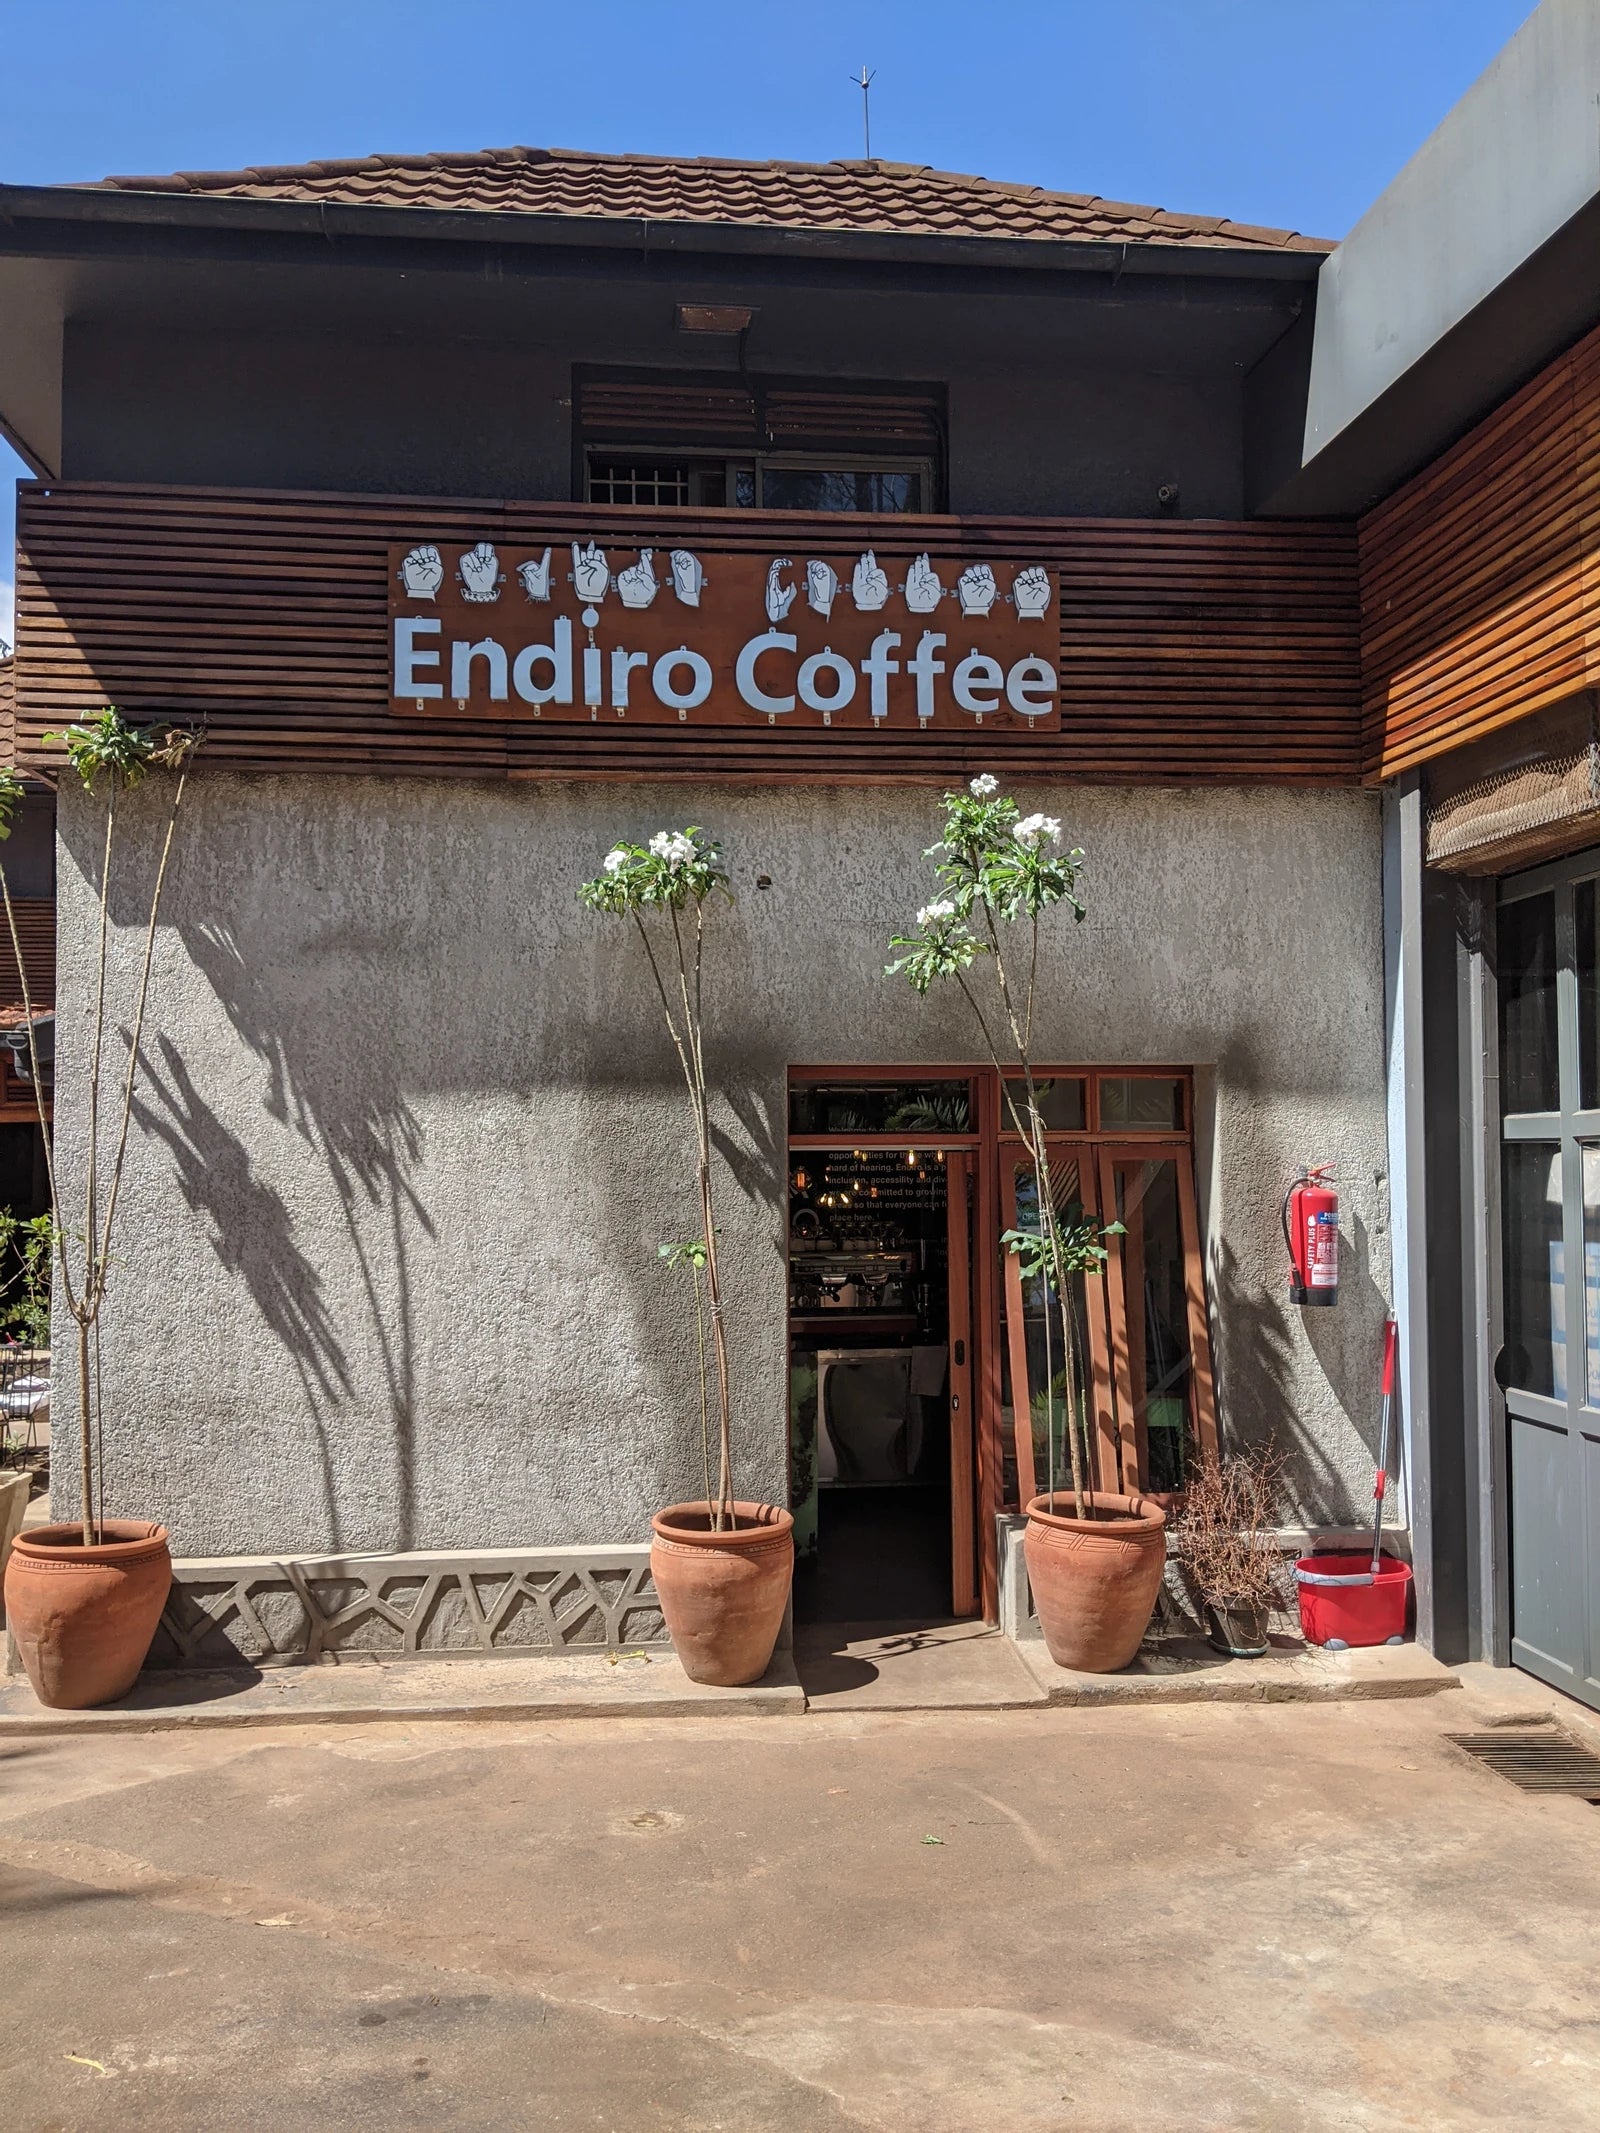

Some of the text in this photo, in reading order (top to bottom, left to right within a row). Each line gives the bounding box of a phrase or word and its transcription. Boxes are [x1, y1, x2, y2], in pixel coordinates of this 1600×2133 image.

[394, 607, 1058, 716] Endiro Coffee
[828, 1151, 884, 1161] opporities
[885, 1151, 898, 1159] for
[829, 1163, 848, 1172] hard
[849, 1163, 858, 1172] of
[860, 1163, 894, 1173] hearing.
[858, 1188, 903, 1197] comitted
[905, 1188, 914, 1197] to
[866, 1200, 883, 1209] that
[884, 1201, 923, 1211] everyone
[829, 1213, 853, 1223] place
[1308, 1227, 1317, 1244] PLUS
